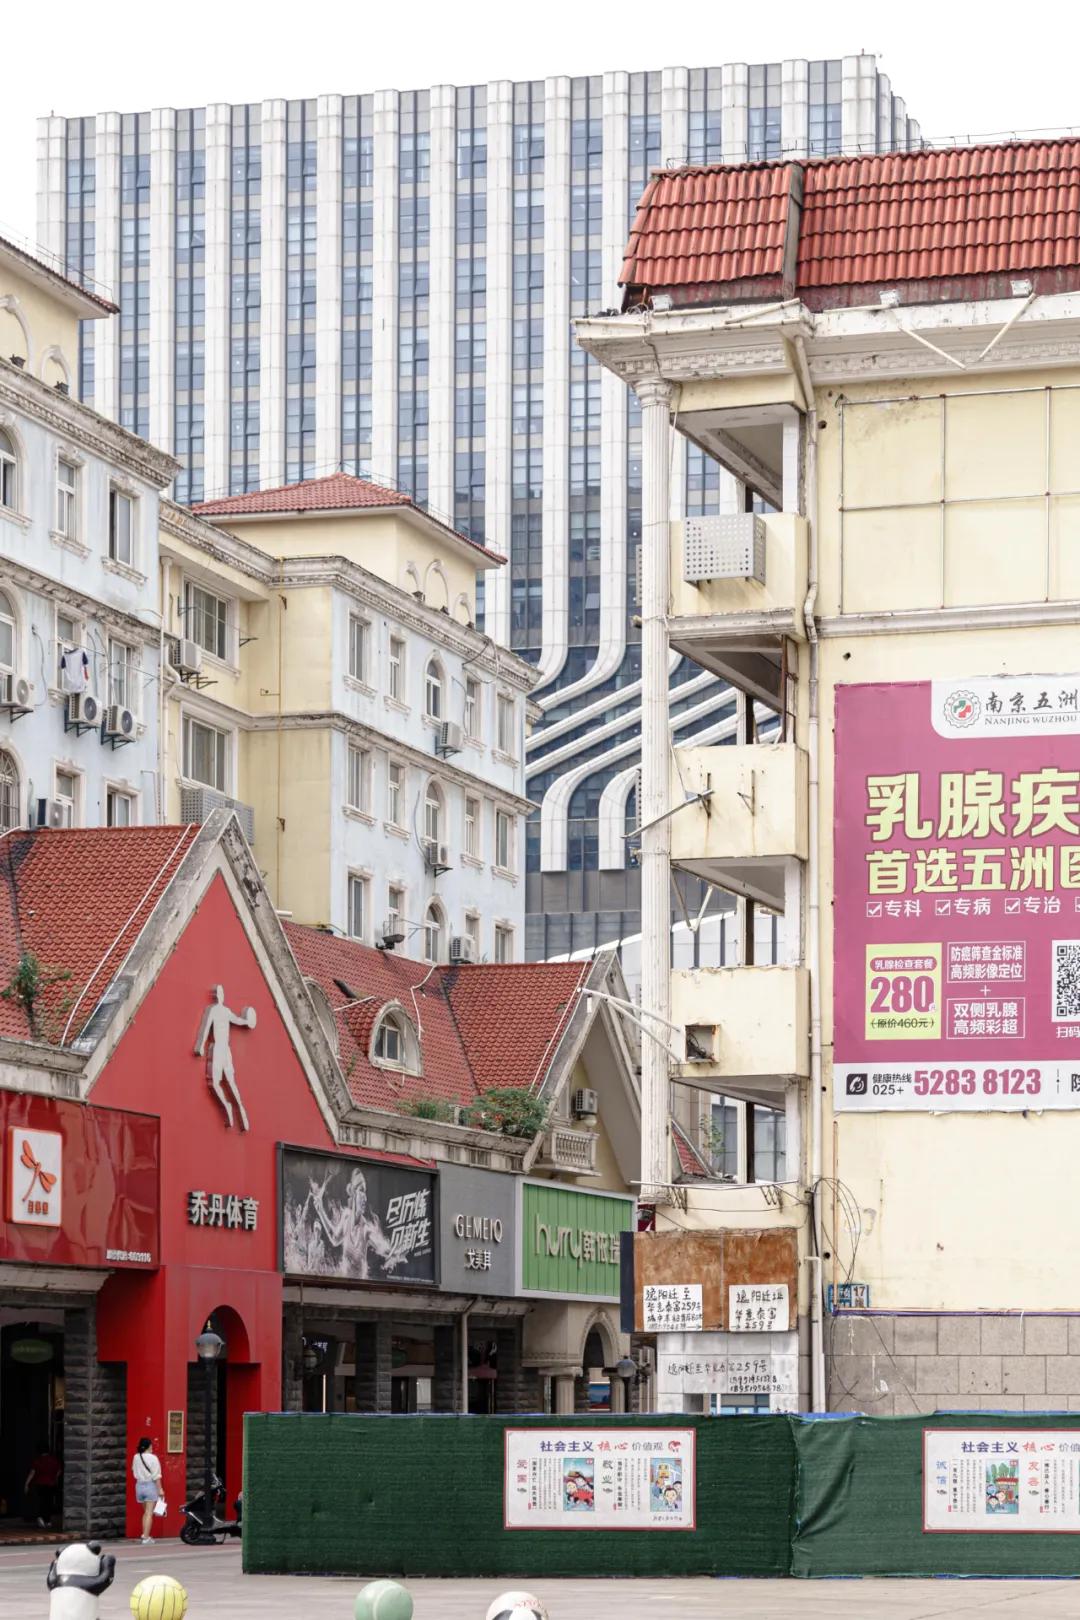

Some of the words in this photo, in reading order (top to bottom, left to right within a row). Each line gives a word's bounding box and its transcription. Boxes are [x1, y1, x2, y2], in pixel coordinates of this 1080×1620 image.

[986, 688, 1078, 713] 南京五洲
[985, 716, 1030, 726] NANJING
[1033, 714, 1077, 724] WUZHOU
[866, 768, 1080, 840] 乳腺疾
[885, 900, 921, 917] 专科
[954, 897, 991, 915] 专病
[1023, 896, 1061, 914] 专治
[951, 963, 1023, 979] 高频影像定位
[870, 975, 935, 1013] 280
[954, 1002, 1018, 1018] 双侧乳腺
[954, 1019, 1018, 1035] 高频彩超
[872, 1073, 912, 1084] 健康热线
[914, 1069, 976, 1095] 5283
[983, 1069, 1041, 1095] 8123
[191, 1190, 260, 1231] 乔丹体育
